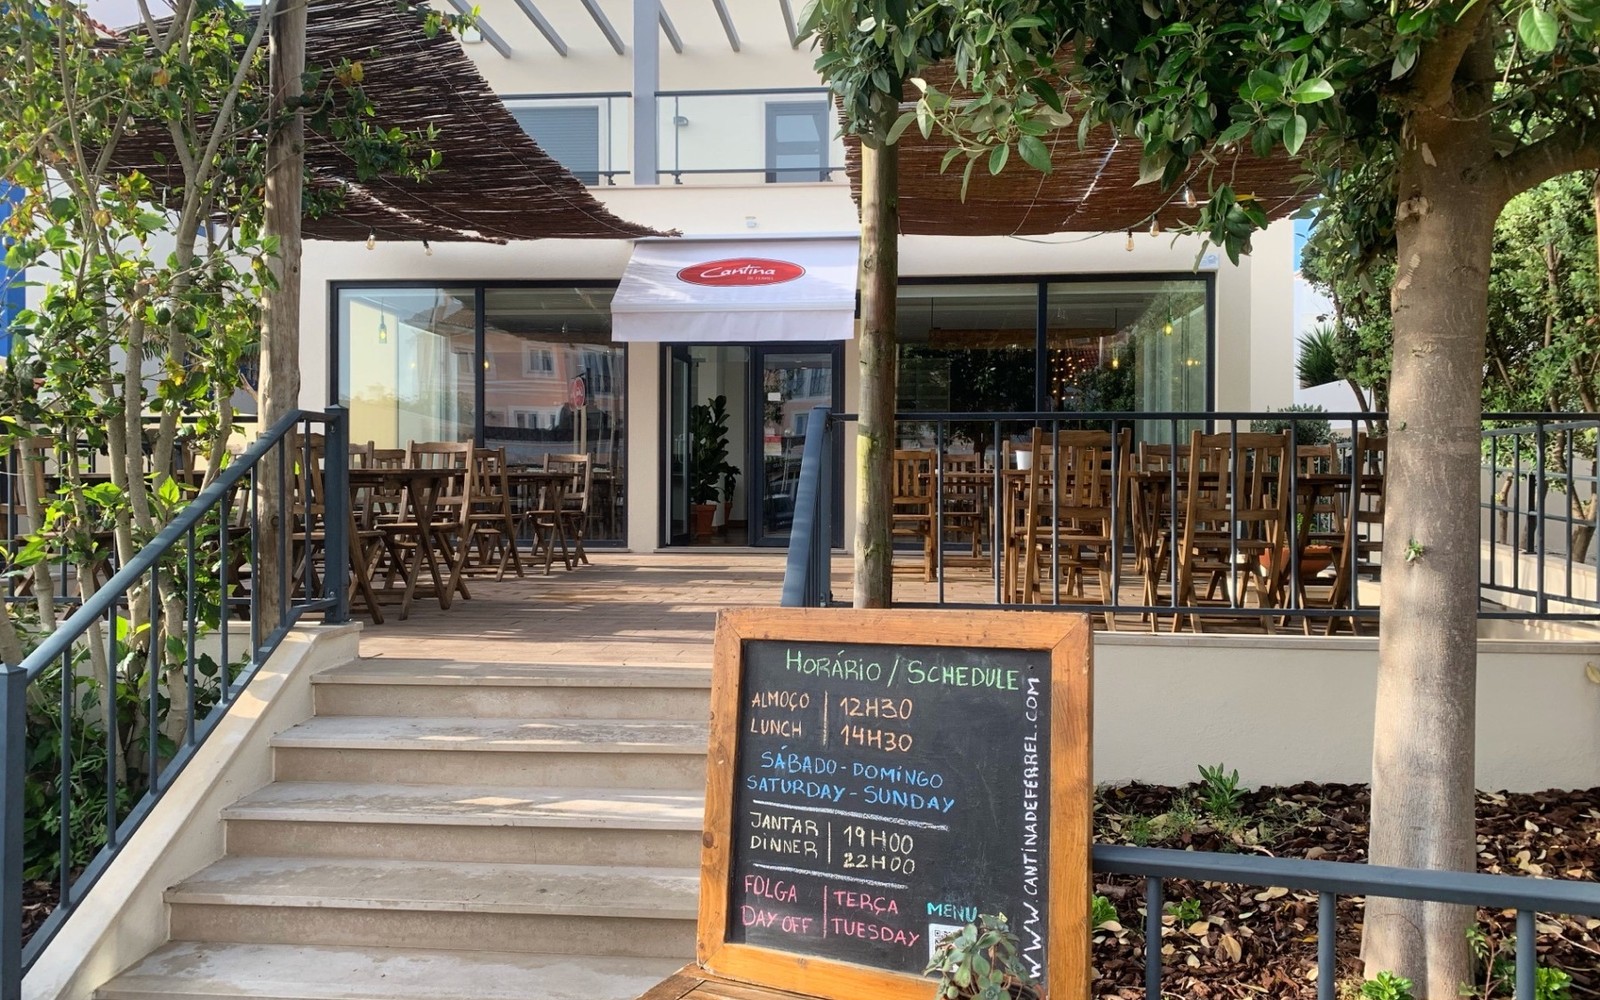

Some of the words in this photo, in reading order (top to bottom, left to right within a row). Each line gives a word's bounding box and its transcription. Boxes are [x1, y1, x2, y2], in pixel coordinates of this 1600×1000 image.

[701, 264, 776, 278] Cantina
[786, 649, 881, 681] HORÁRIO
[907, 660, 1020, 690] SCHEDULE
[752, 690, 810, 711] ALMOÇO
[840, 697, 913, 719] 12H30
[750, 718, 802, 738] LUNCH
[840, 724, 913, 752] 14H30
[761, 745, 837, 775] SÁBADO
[747, 775, 846, 802] SATURDAY
[863, 785, 955, 813] SUNDAY
[750, 812, 819, 837] JANTAR
[843, 826, 914, 855] 19H00
[1021, 677, 1042, 978] WWW.CANTINADEFERREL.COM
[750, 833, 818, 859] DINNER
[843, 852, 916, 875] 22H00
[744, 875, 798, 903] FOLGA
[833, 891, 899, 915] TERÇA
[927, 902, 978, 923] MENU
[740, 905, 778, 927] DAY
[781, 915, 813, 934] OFF
[831, 918, 920, 947] TUESDAY
